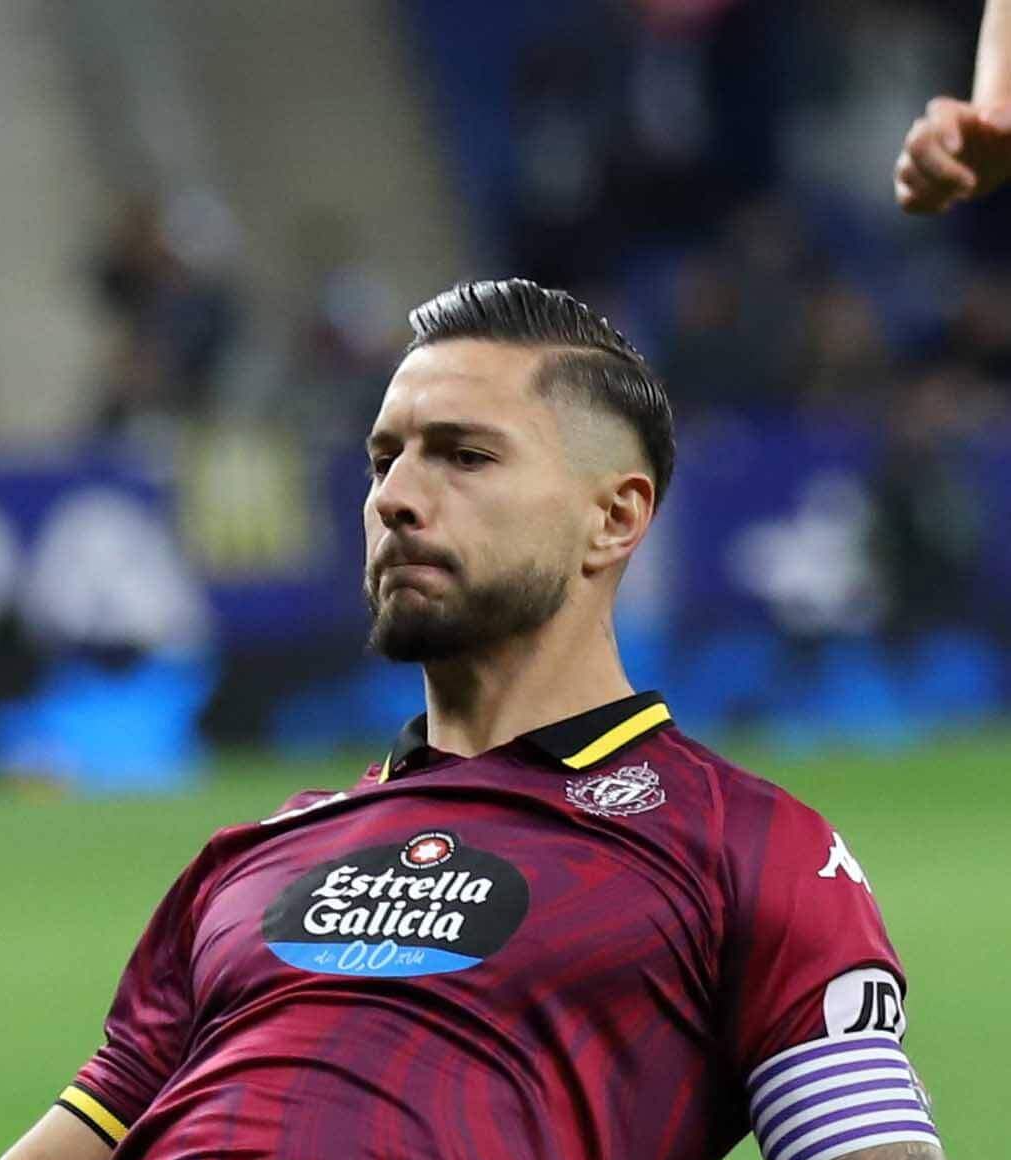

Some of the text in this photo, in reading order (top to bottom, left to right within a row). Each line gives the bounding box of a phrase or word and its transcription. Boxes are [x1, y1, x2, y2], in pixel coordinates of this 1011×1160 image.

[311, 866, 493, 904] Estrella
[304, 899, 464, 941] Galicia
[338, 939, 398, 970] 0,0
